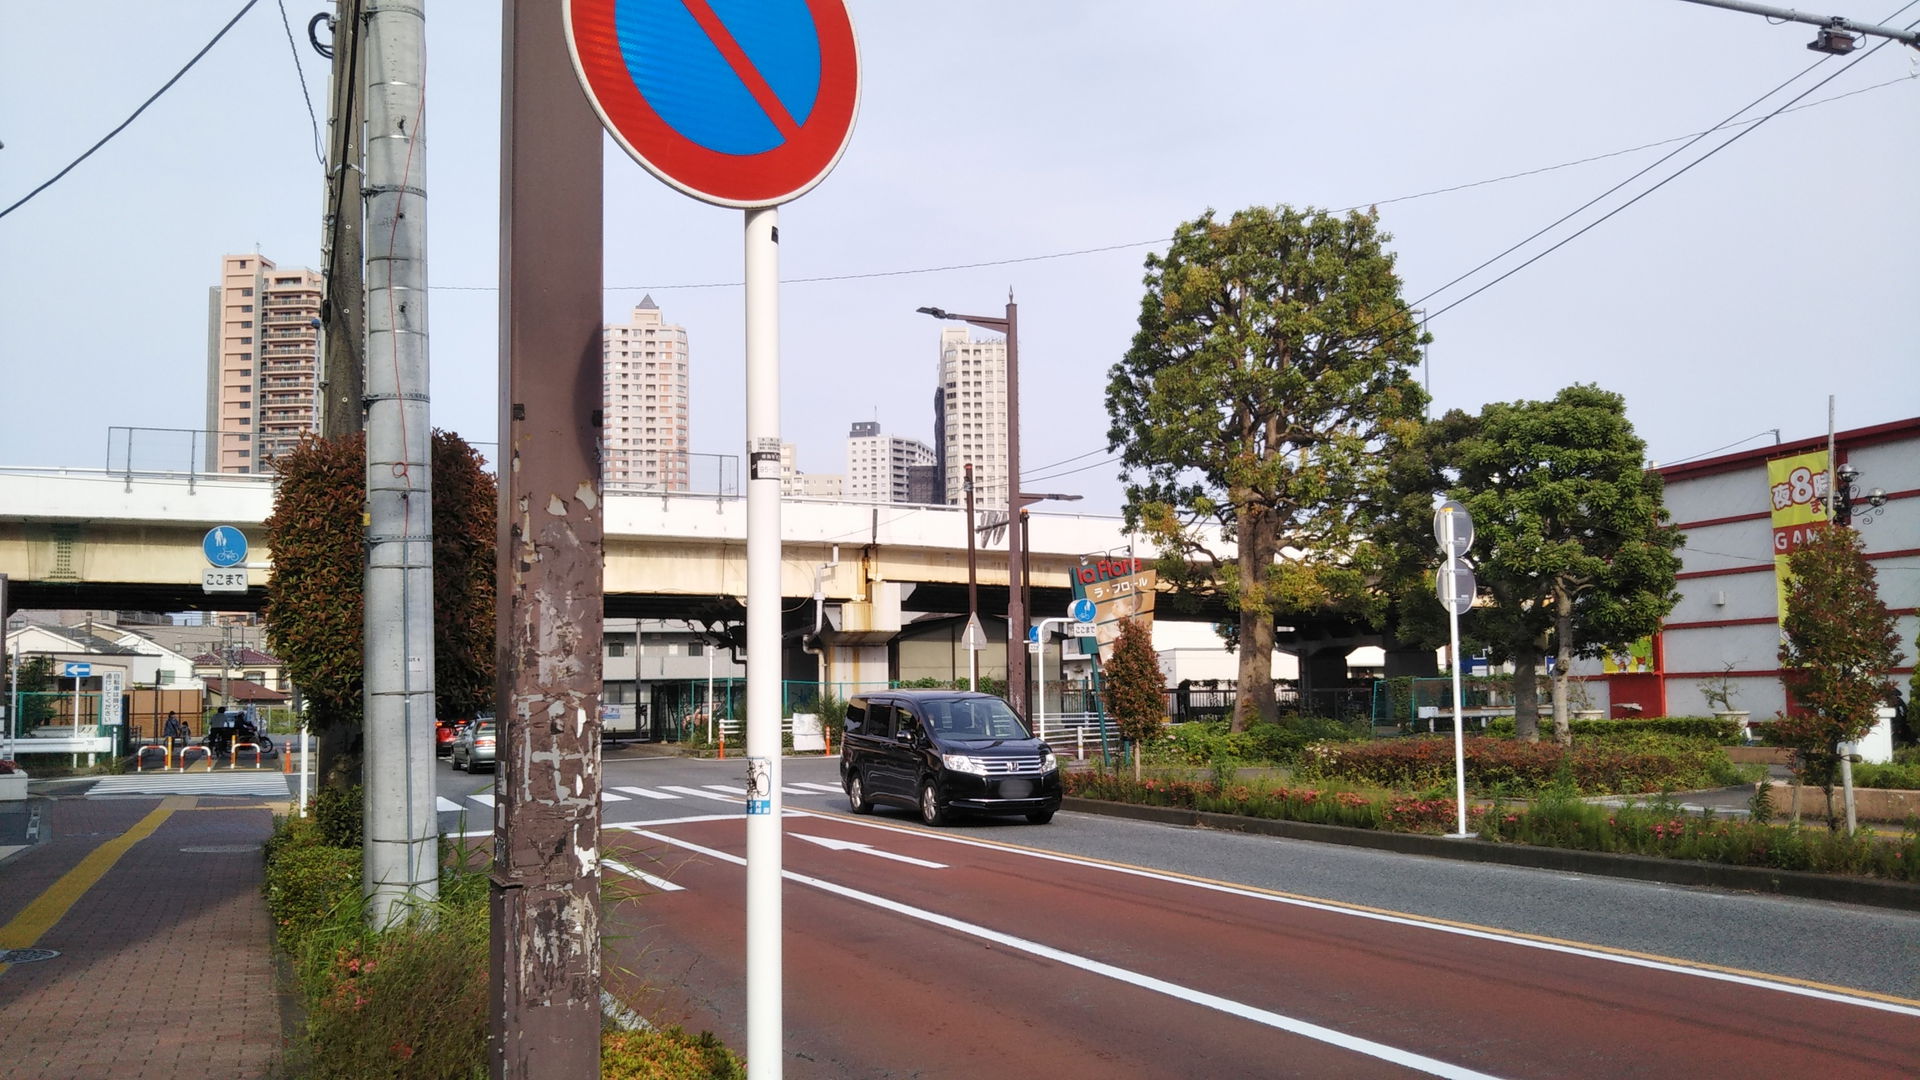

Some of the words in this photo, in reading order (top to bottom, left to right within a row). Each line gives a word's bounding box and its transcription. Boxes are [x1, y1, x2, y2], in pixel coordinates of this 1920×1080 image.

[206, 573, 244, 586] ここまで
[1094, 577, 1148, 598] ラ・フロール
[1075, 625, 1096, 634] ここまで
